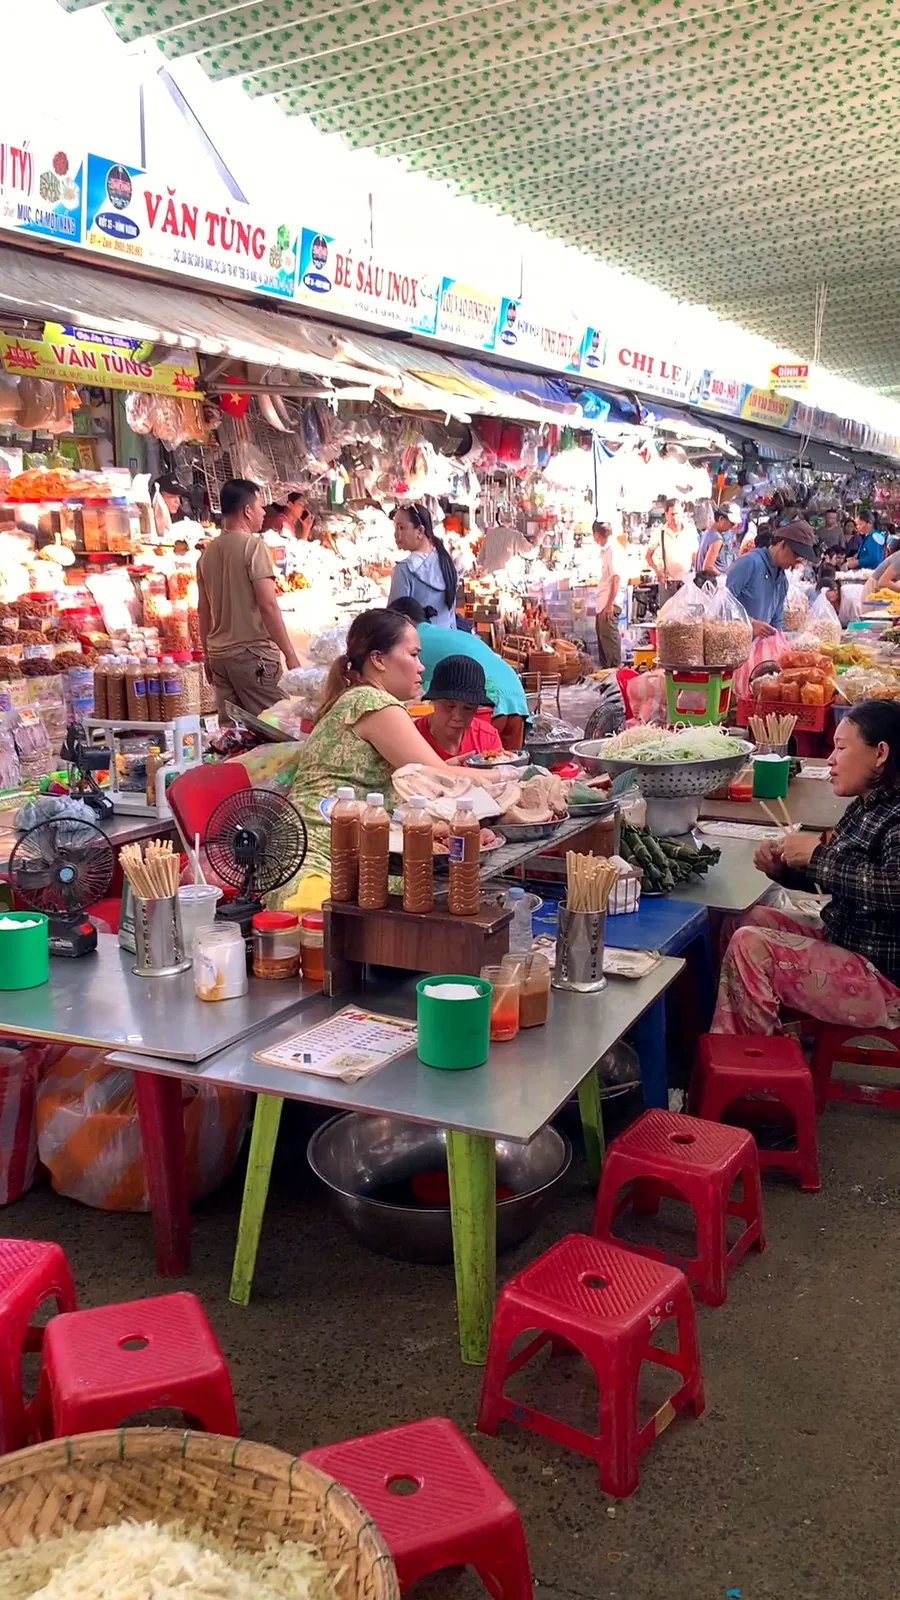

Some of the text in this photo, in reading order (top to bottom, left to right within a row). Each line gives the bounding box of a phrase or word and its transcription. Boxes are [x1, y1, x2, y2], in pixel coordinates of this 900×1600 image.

[144, 185, 198, 241] VĂN
[205, 207, 265, 260] TÙNG
[334, 248, 352, 288] BÉ
[356, 255, 384, 297] SÁU
[387, 271, 418, 308] INOX
[51, 343, 97, 370] VĂN
[101, 352, 153, 378] TÙNG
[618, 348, 681, 385] CHỊ LẸ
[800, 367, 807, 376] 7
